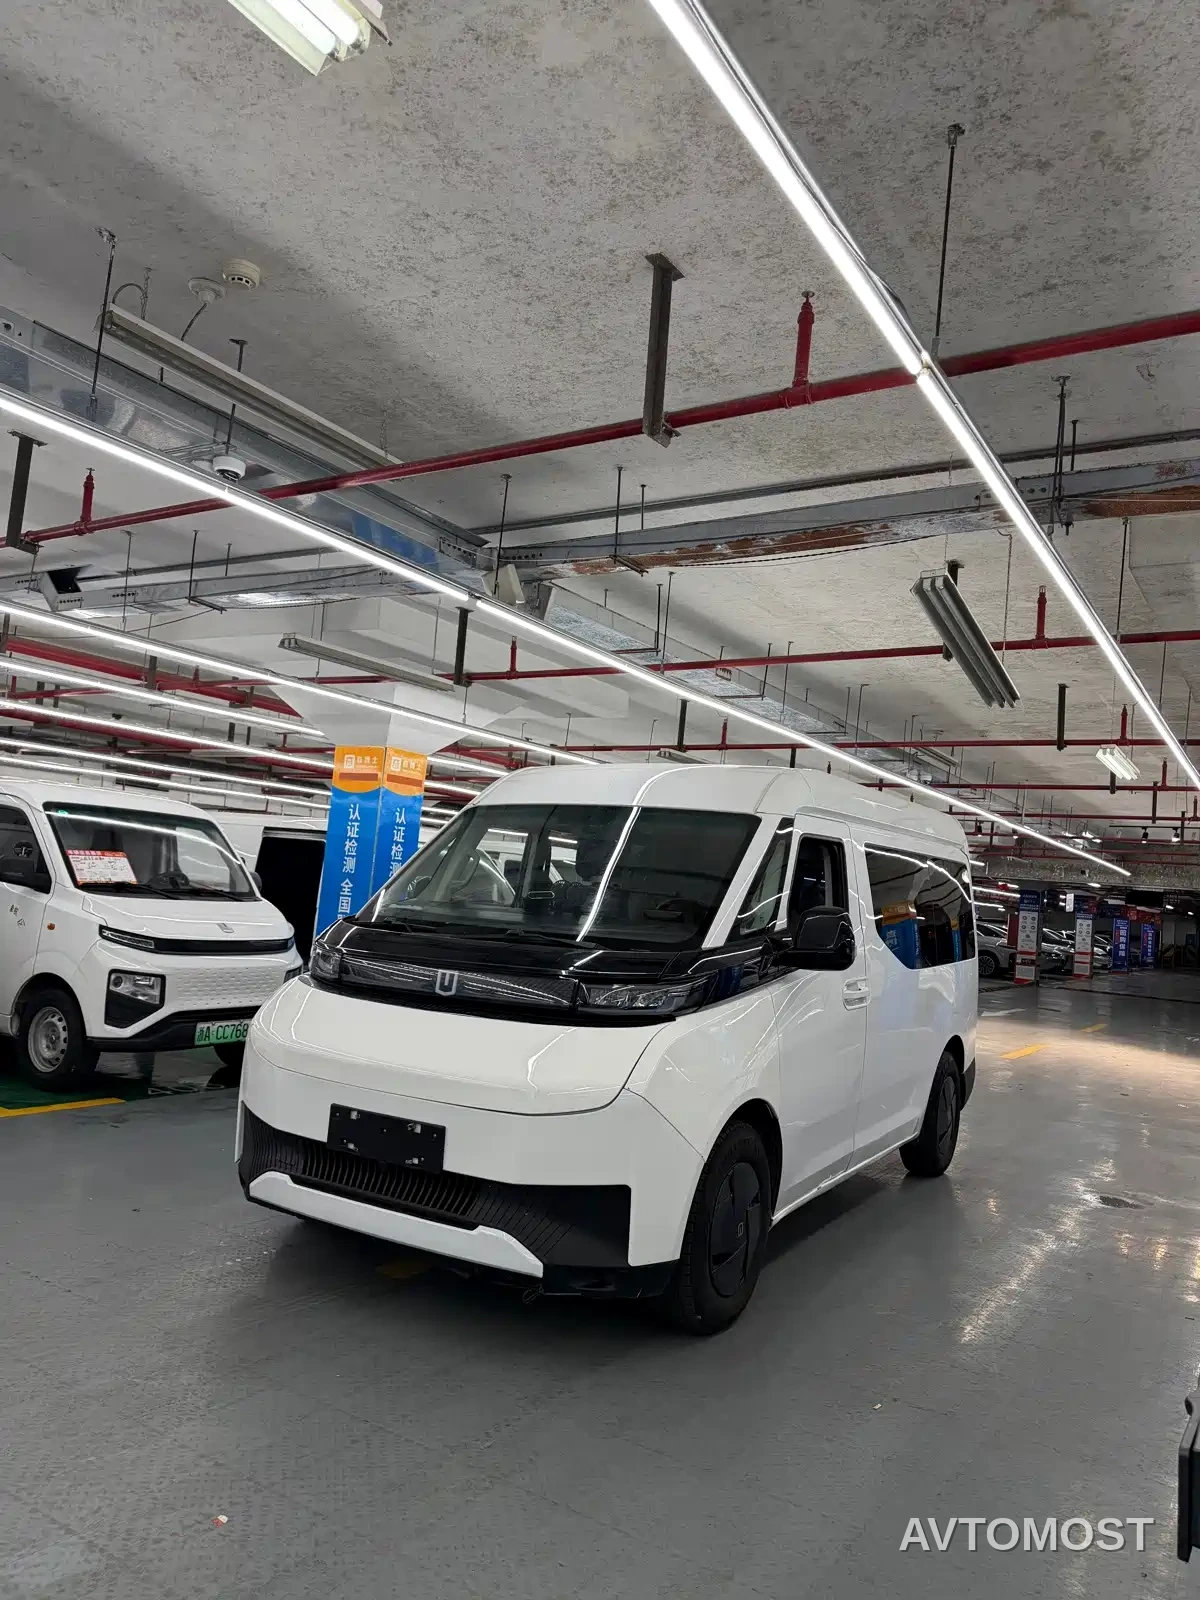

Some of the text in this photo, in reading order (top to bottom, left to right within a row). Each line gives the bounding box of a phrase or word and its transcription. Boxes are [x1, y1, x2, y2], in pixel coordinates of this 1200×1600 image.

[337, 803, 361, 920] 认证检测 全国
